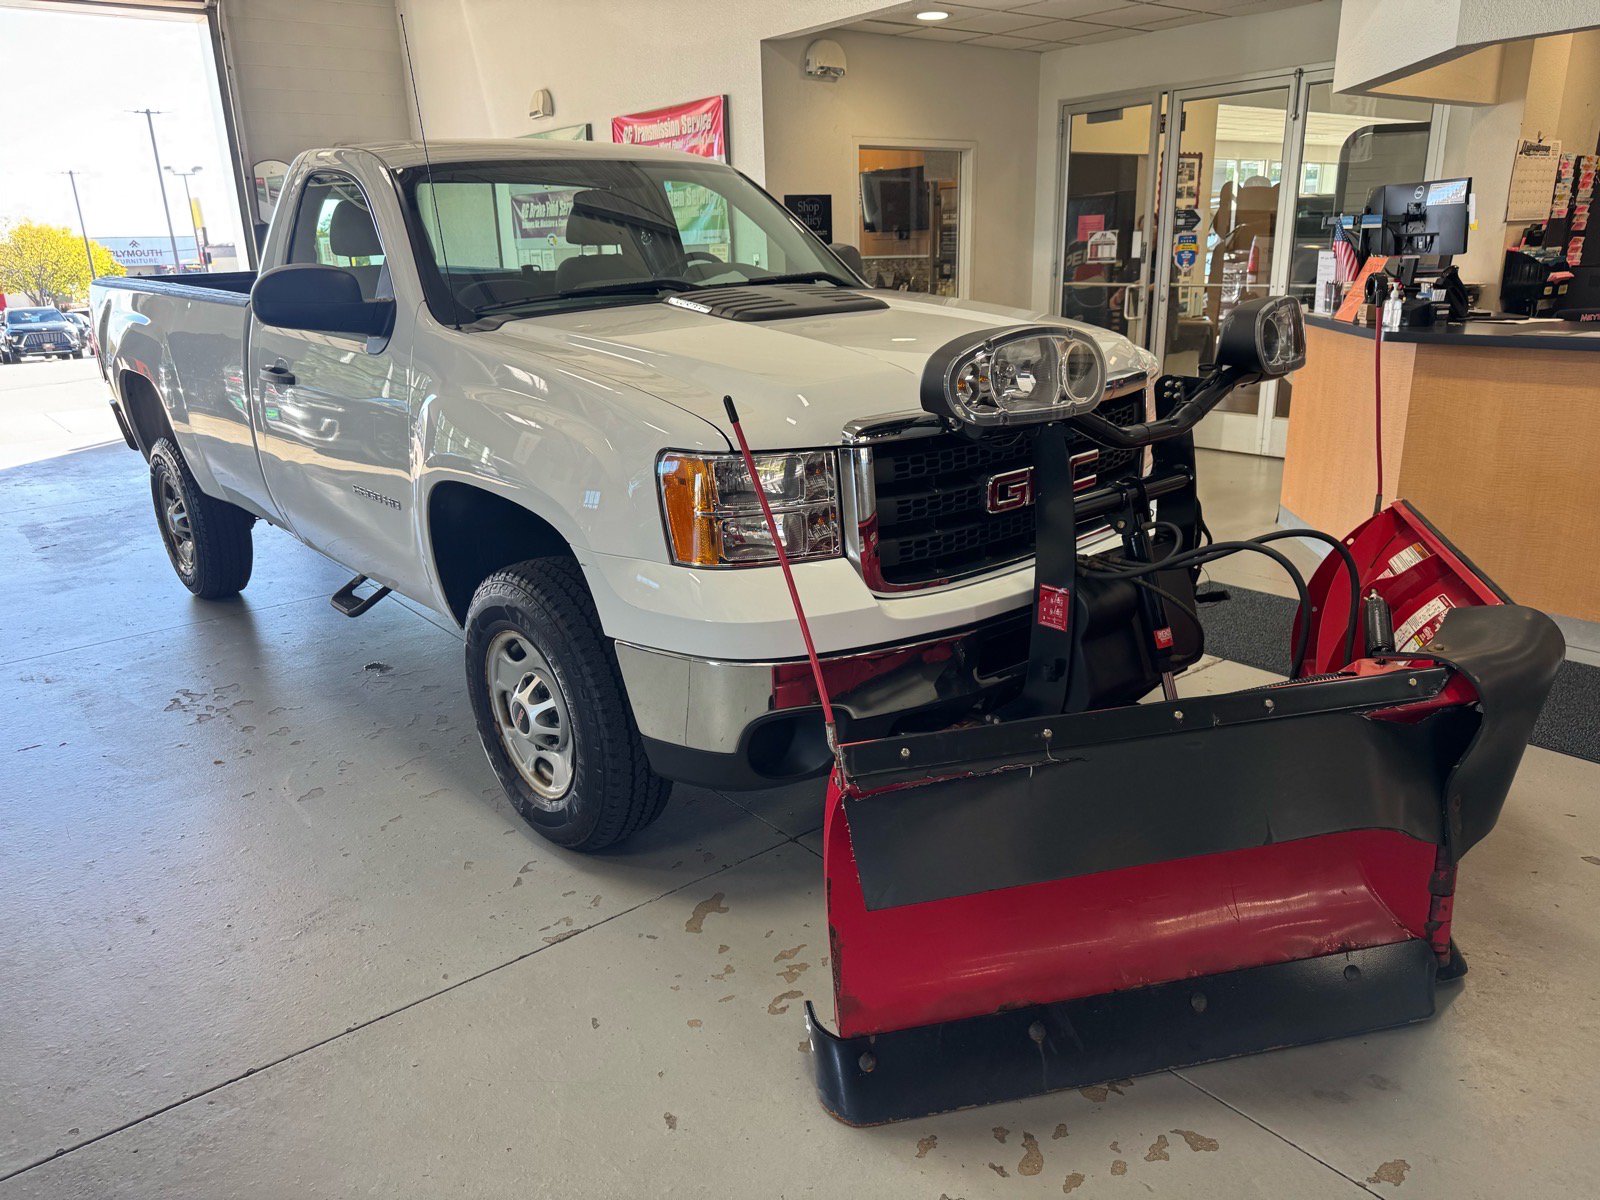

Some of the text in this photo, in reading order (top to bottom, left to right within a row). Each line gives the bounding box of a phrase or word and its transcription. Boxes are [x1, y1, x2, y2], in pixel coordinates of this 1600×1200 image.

[634, 118, 680, 142] Transmission
[681, 112, 712, 135] Service
[797, 200, 820, 215] Shop
[986, 448, 1099, 514] GC
